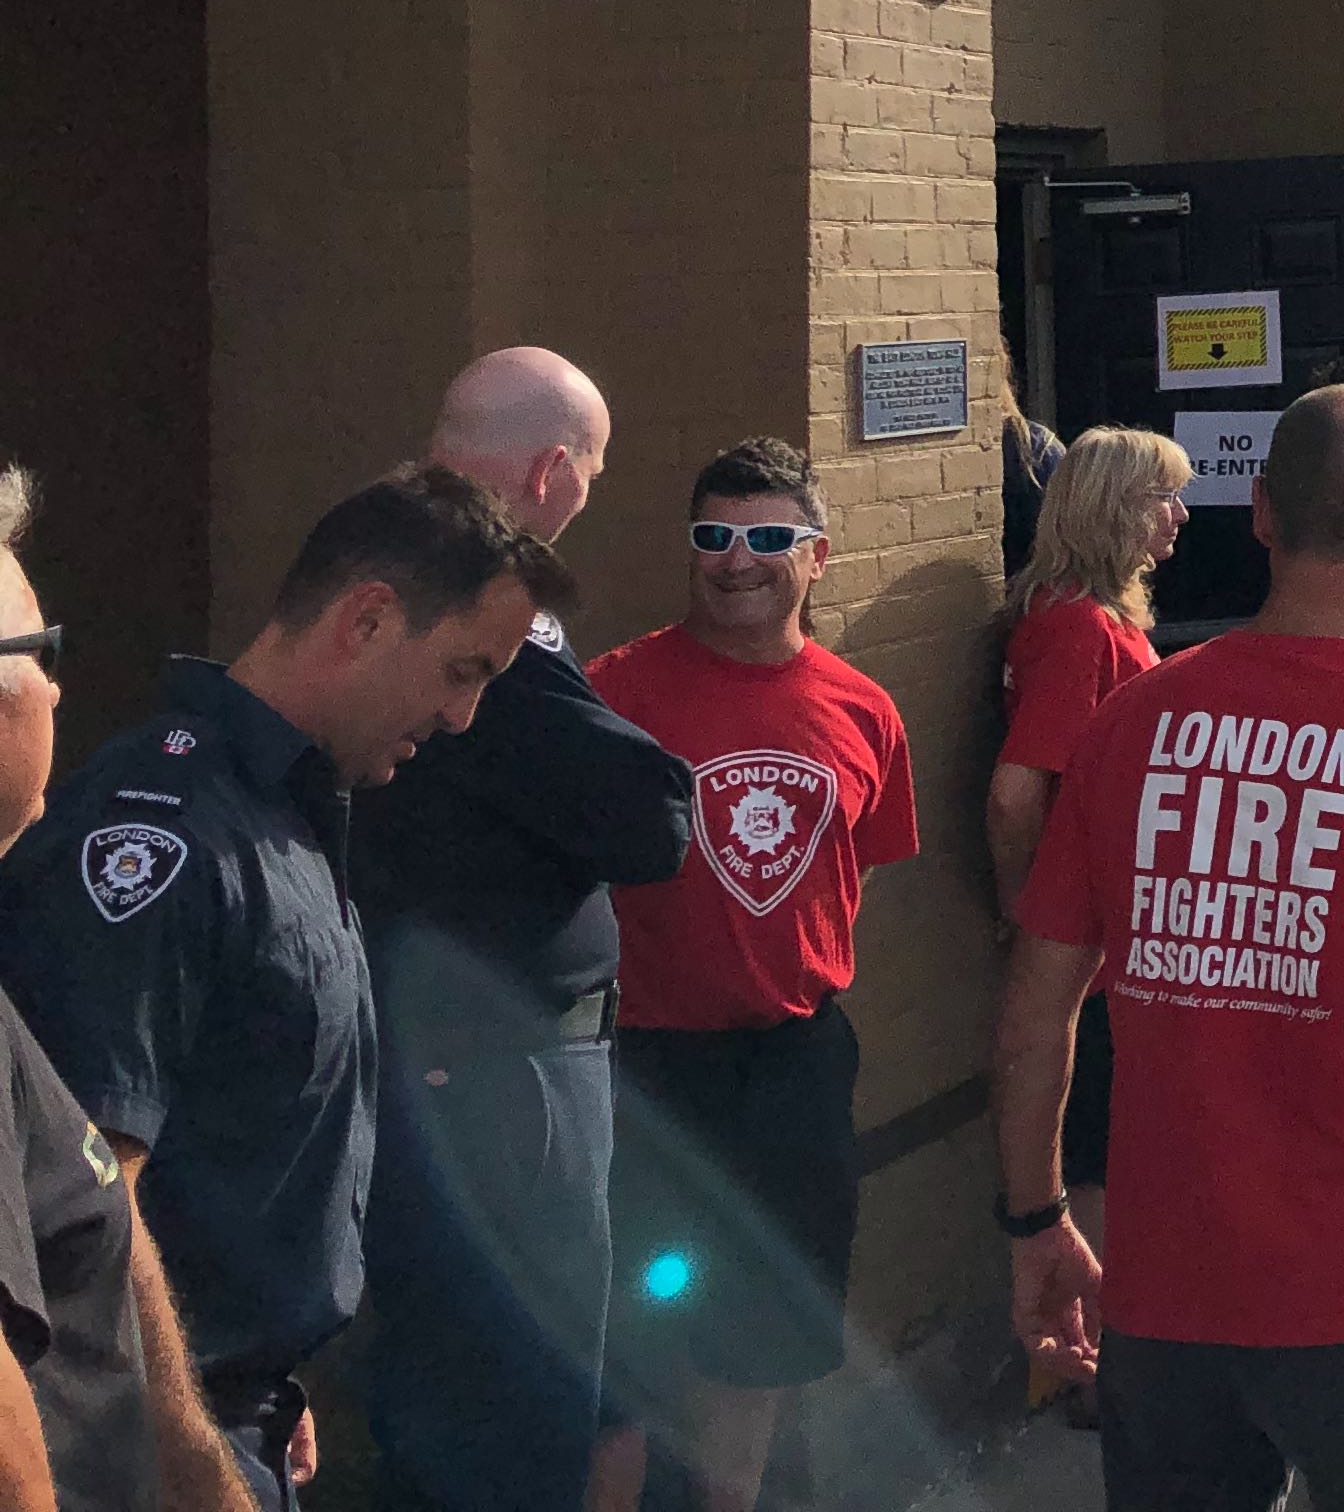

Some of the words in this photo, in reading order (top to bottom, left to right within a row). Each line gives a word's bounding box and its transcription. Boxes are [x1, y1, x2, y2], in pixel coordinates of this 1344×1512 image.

[1172, 321, 1205, 331] PLEASE
[1206, 320, 1218, 329] BE
[1173, 334, 1207, 344] WATCH
[1210, 332, 1236, 342] YOUR
[1237, 331, 1258, 340] STEP
[1218, 435, 1253, 452] NO
[1191, 459, 1268, 476] E-ENT
[709, 766, 819, 793] LONDON
[115, 789, 182, 805] FIREFIGHTER
[96, 829, 177, 853] LONDON
[719, 844, 754, 878] FIRE
[761, 845, 805, 879] DEPT.
[93, 881, 118, 903] FIRE
[1131, 875, 1329, 954] FIGHTERS
[1125, 937, 1321, 999] ASSOCIATION
[1113, 980, 1155, 1006] Working
[1157, 990, 1168, 1002] to
[1169, 992, 1201, 1008] make
[1203, 996, 1227, 1009] our
[1229, 999, 1300, 1021] community
[1300, 1004, 1333, 1024] safer!
